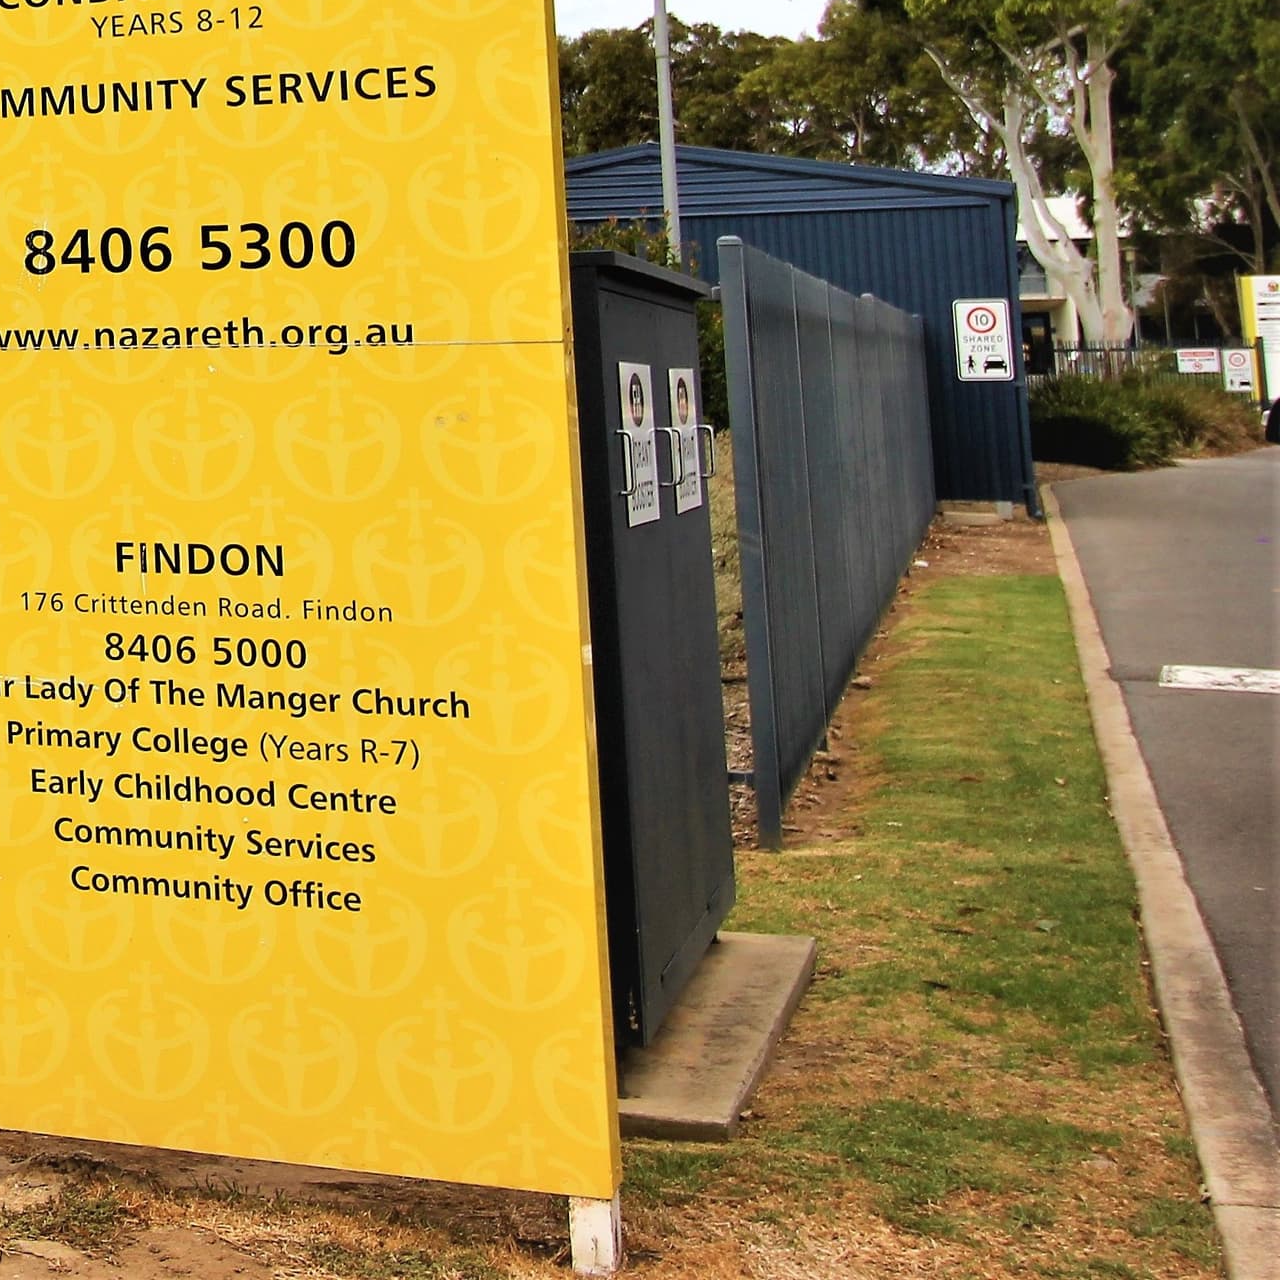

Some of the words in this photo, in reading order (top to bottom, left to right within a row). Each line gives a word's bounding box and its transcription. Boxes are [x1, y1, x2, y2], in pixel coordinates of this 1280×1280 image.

[90, 11, 183, 38] YEARS
[197, 5, 263, 32] 8-12
[225, 65, 436, 107] SERVICES
[24, 225, 172, 276] 8406
[200, 220, 355, 271] 5300
[975, 314, 989, 326] 10
[115, 542, 284, 577] FINDON
[20, 591, 64, 613] 176
[74, 592, 207, 617] Crittenden
[302, 599, 393, 623] Findon
[105, 632, 196, 665] 8406
[213, 637, 307, 669] 5000
[25, 674, 94, 708] Lady
[104, 677, 140, 704] Of
[149, 679, 205, 707] The
[216, 683, 341, 718] Manger
[352, 687, 470, 719] Church
[7, 720, 122, 757] Primary
[132, 726, 248, 763] College
[259, 731, 349, 763] (Years
[360, 738, 420, 771] R-7)
[31, 768, 104, 803] Early
[114, 772, 275, 807] Childhood
[288, 783, 397, 815] Centre
[54, 817, 235, 860] Community
[246, 829, 376, 863] Services
[71, 865, 253, 910] Community
[264, 880, 362, 912] Office
